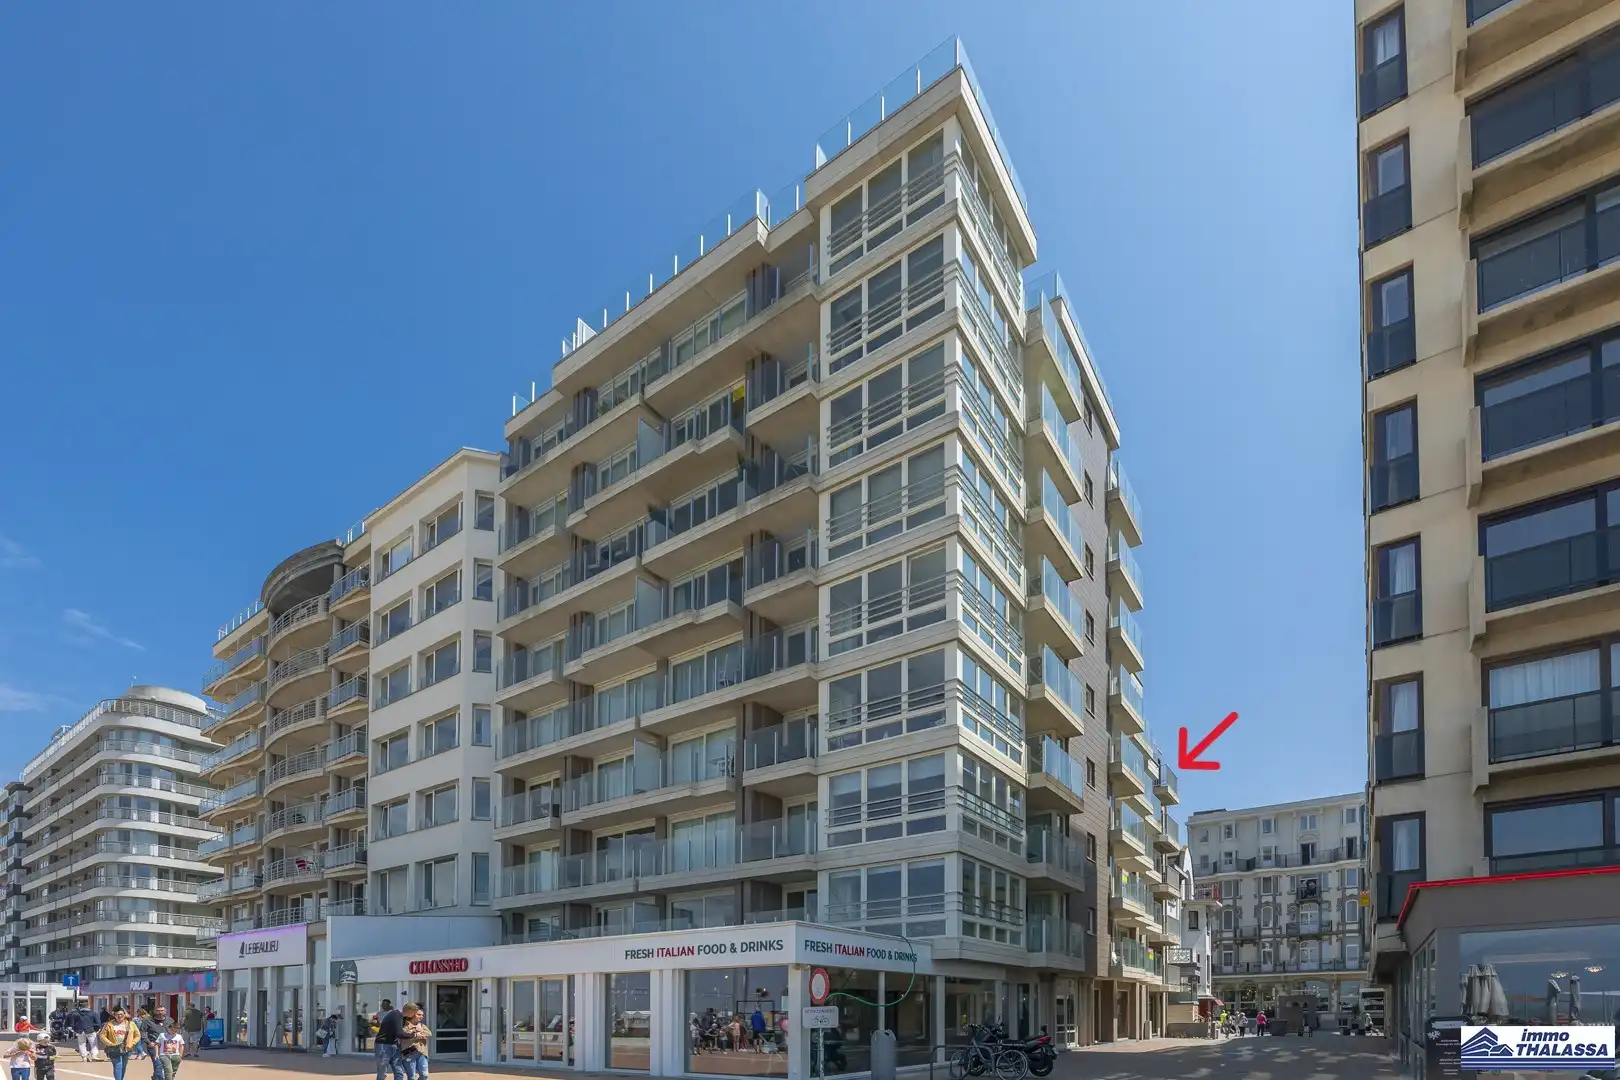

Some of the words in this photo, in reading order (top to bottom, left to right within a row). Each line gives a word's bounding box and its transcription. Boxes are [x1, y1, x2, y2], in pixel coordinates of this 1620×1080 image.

[625, 948, 654, 960] FRESH
[656, 945, 695, 958] ITALIAN
[697, 943, 727, 956] FOOD
[730, 942, 737, 953] &
[740, 939, 784, 953] DRINKS
[804, 940, 832, 953] FRESH
[834, 943, 865, 957] ITALIAN
[866, 947, 886, 960] FOOD
[888, 950, 893, 960] &
[894, 950, 918, 962] DRINKS
[409, 958, 468, 974] COLOSSEO
